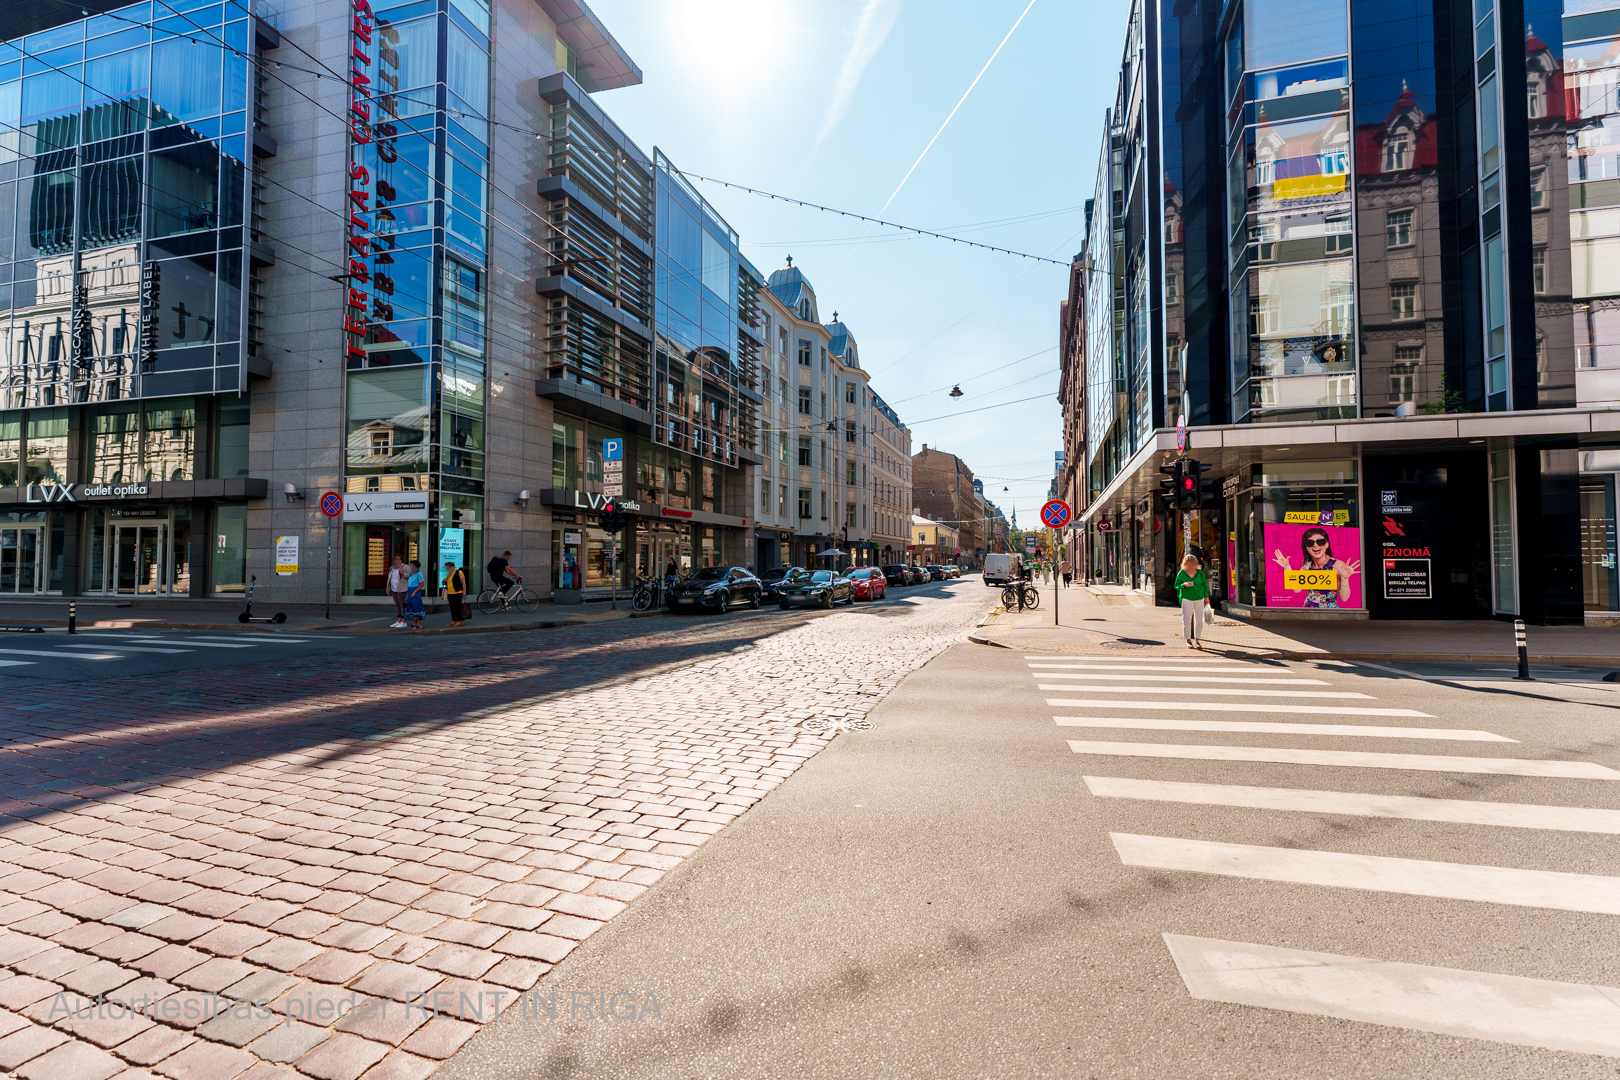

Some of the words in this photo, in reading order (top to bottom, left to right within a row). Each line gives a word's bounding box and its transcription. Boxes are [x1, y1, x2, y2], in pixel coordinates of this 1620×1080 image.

[349, 0, 372, 144] CENTRS
[343, 161, 369, 359] TĒRBATAS
[143, 262, 153, 308] LABEL
[141, 314, 151, 362] WHITE
[607, 441, 618, 458] P
[26, 483, 76, 503] LVX
[84, 484, 112, 496] outlet
[114, 482, 148, 498] optika
[575, 490, 613, 511] LVX
[347, 502, 373, 512] LVX
[1287, 513, 1316, 521] SAULE
[1383, 546, 1431, 557] IZNOMĀ
[1289, 574, 1332, 585] -80%
